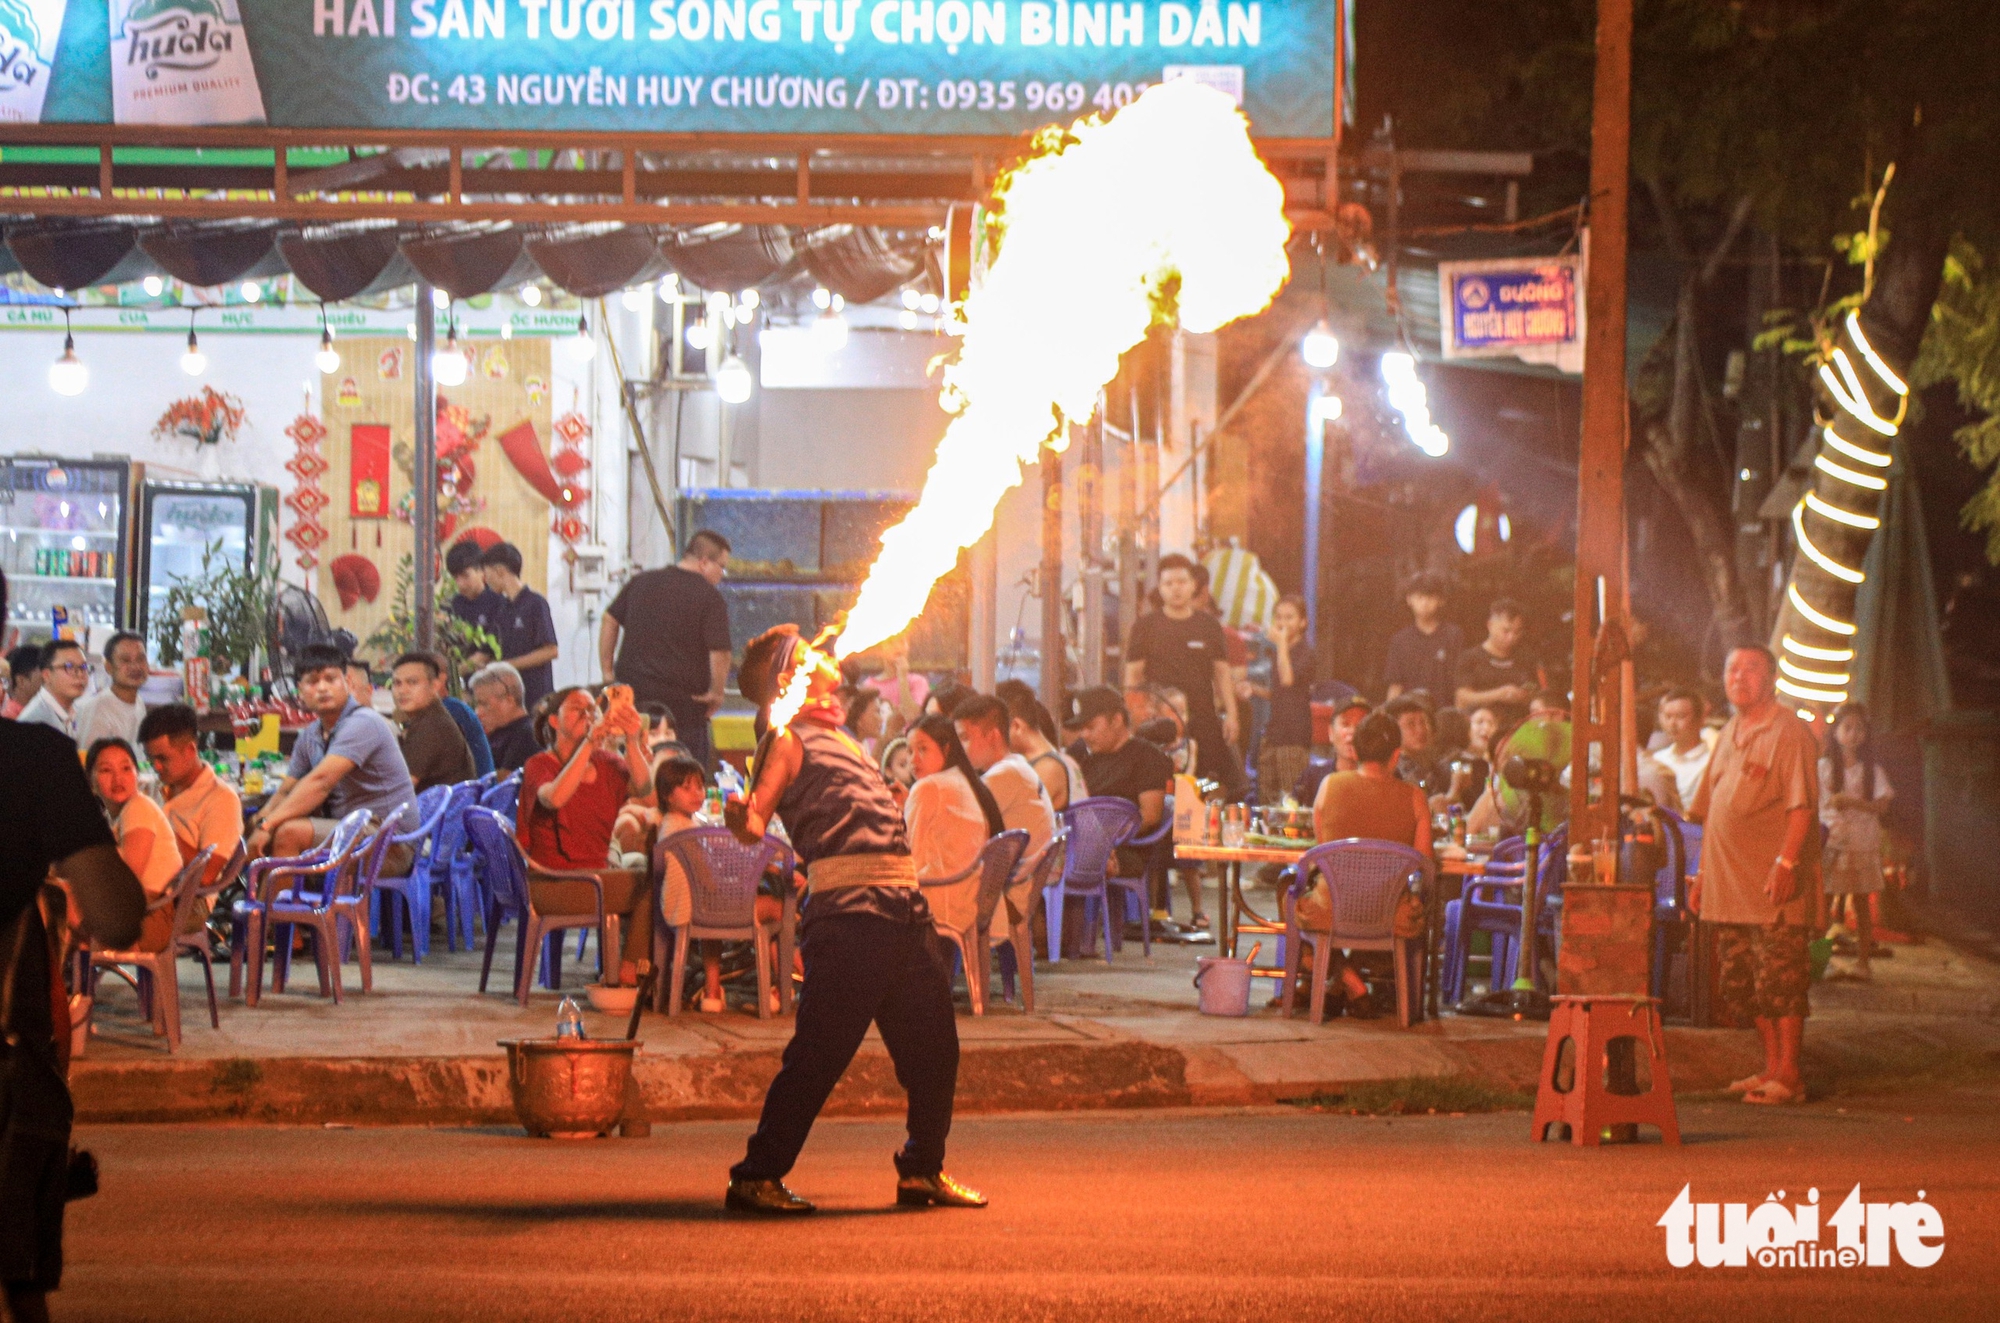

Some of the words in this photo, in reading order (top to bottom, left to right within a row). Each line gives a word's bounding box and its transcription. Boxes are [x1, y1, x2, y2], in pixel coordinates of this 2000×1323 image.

[128, 18, 232, 72] huda
[870, 0, 1006, 55] CHỌN
[133, 85, 189, 101] PREMIUM
[192, 78, 241, 93] QUALITY
[387, 72, 440, 105] ĐC:
[447, 73, 486, 105] 43
[497, 65, 628, 106] NGUYỄN
[637, 76, 703, 107] HUY
[710, 73, 848, 109] CHƯƠNG
[854, 78, 870, 109] /
[876, 78, 929, 109] ĐT:
[936, 79, 1016, 111] 0935
[1025, 80, 1085, 111] 969
[1092, 81, 1149, 113] 40
